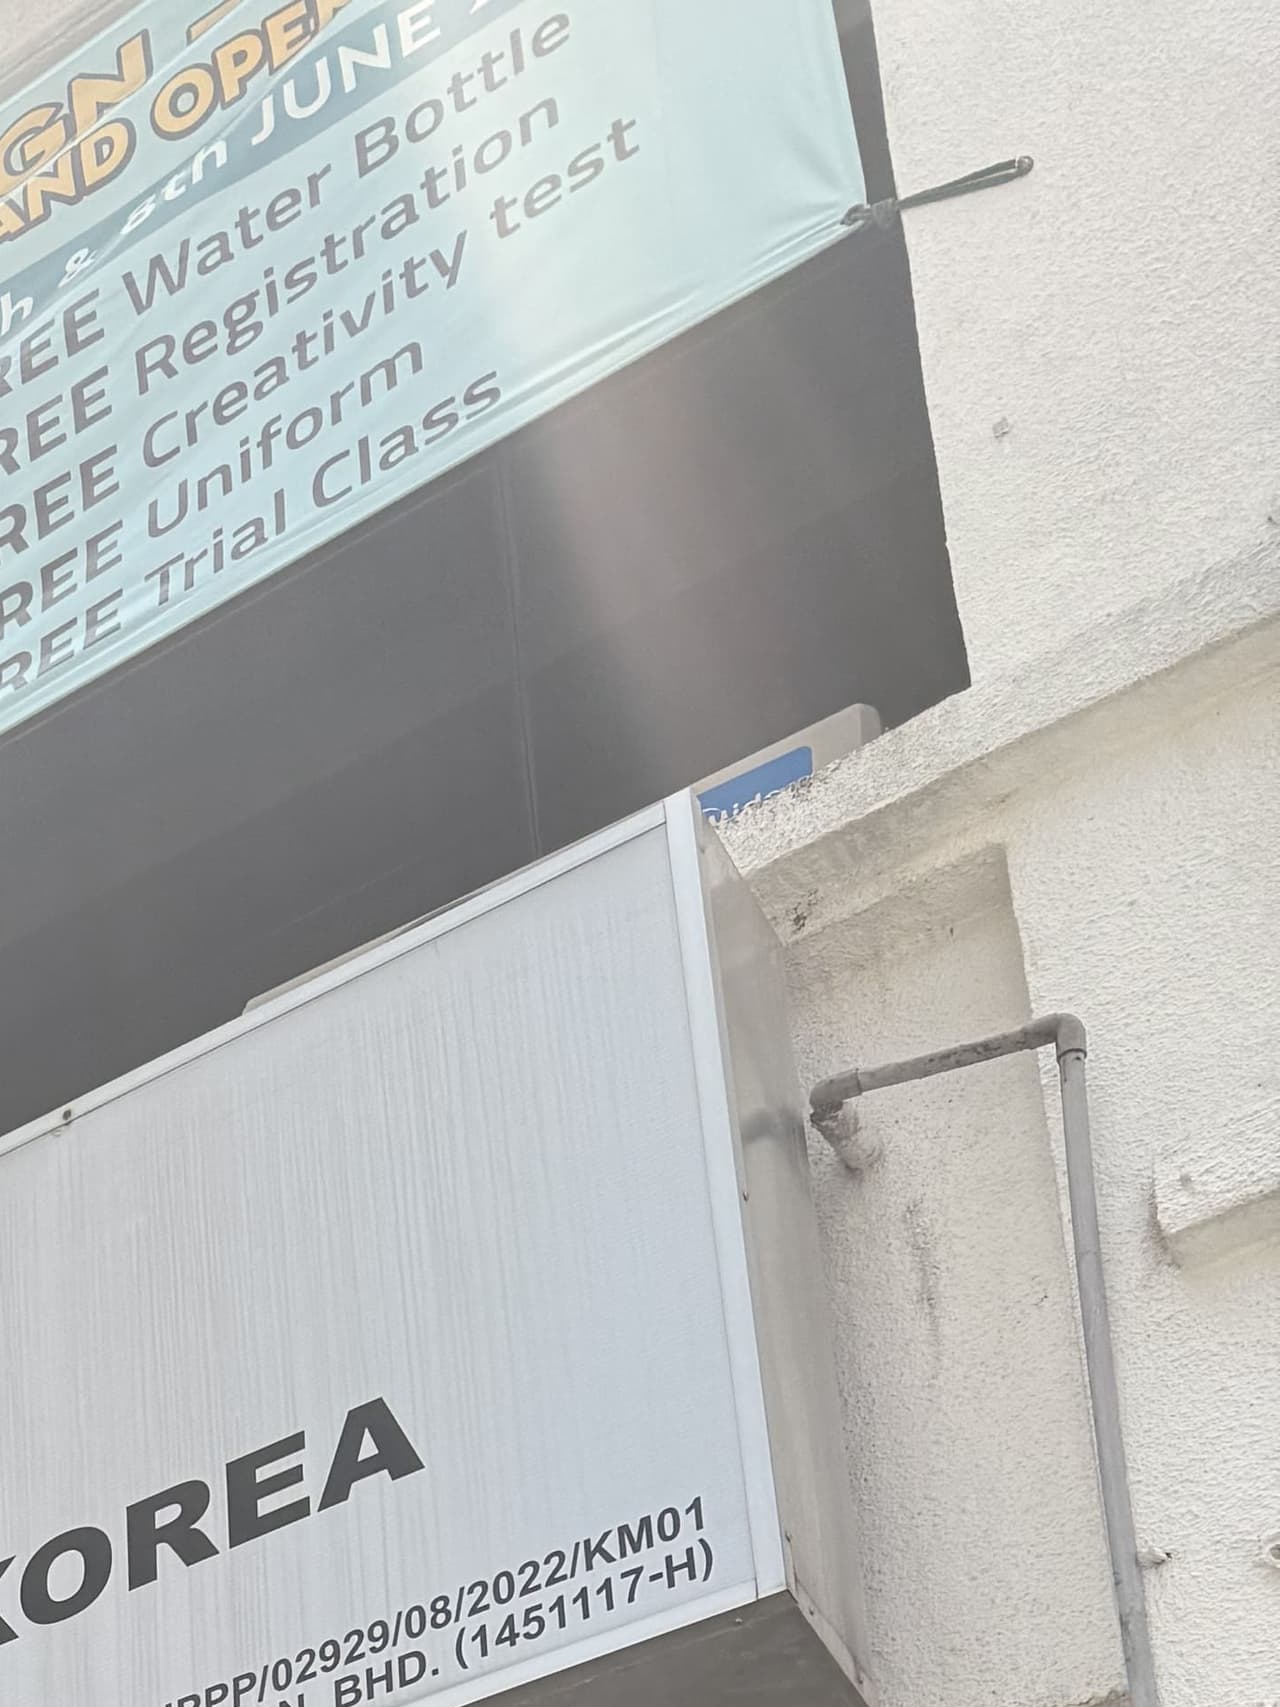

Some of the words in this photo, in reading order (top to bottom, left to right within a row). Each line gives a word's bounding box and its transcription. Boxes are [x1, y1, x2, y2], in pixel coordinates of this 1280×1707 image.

[121, 162, 334, 310] Water
[354, 11, 574, 176] Bottle
[136, 97, 563, 382] Registration
[140, 229, 467, 467] Creativity
[489, 117, 641, 241] test
[145, 514, 289, 606] Trial
[311, 370, 503, 505] Class
[147, 337, 424, 535] Uniform
[455, 1537, 714, 1669] (1451117-H)
